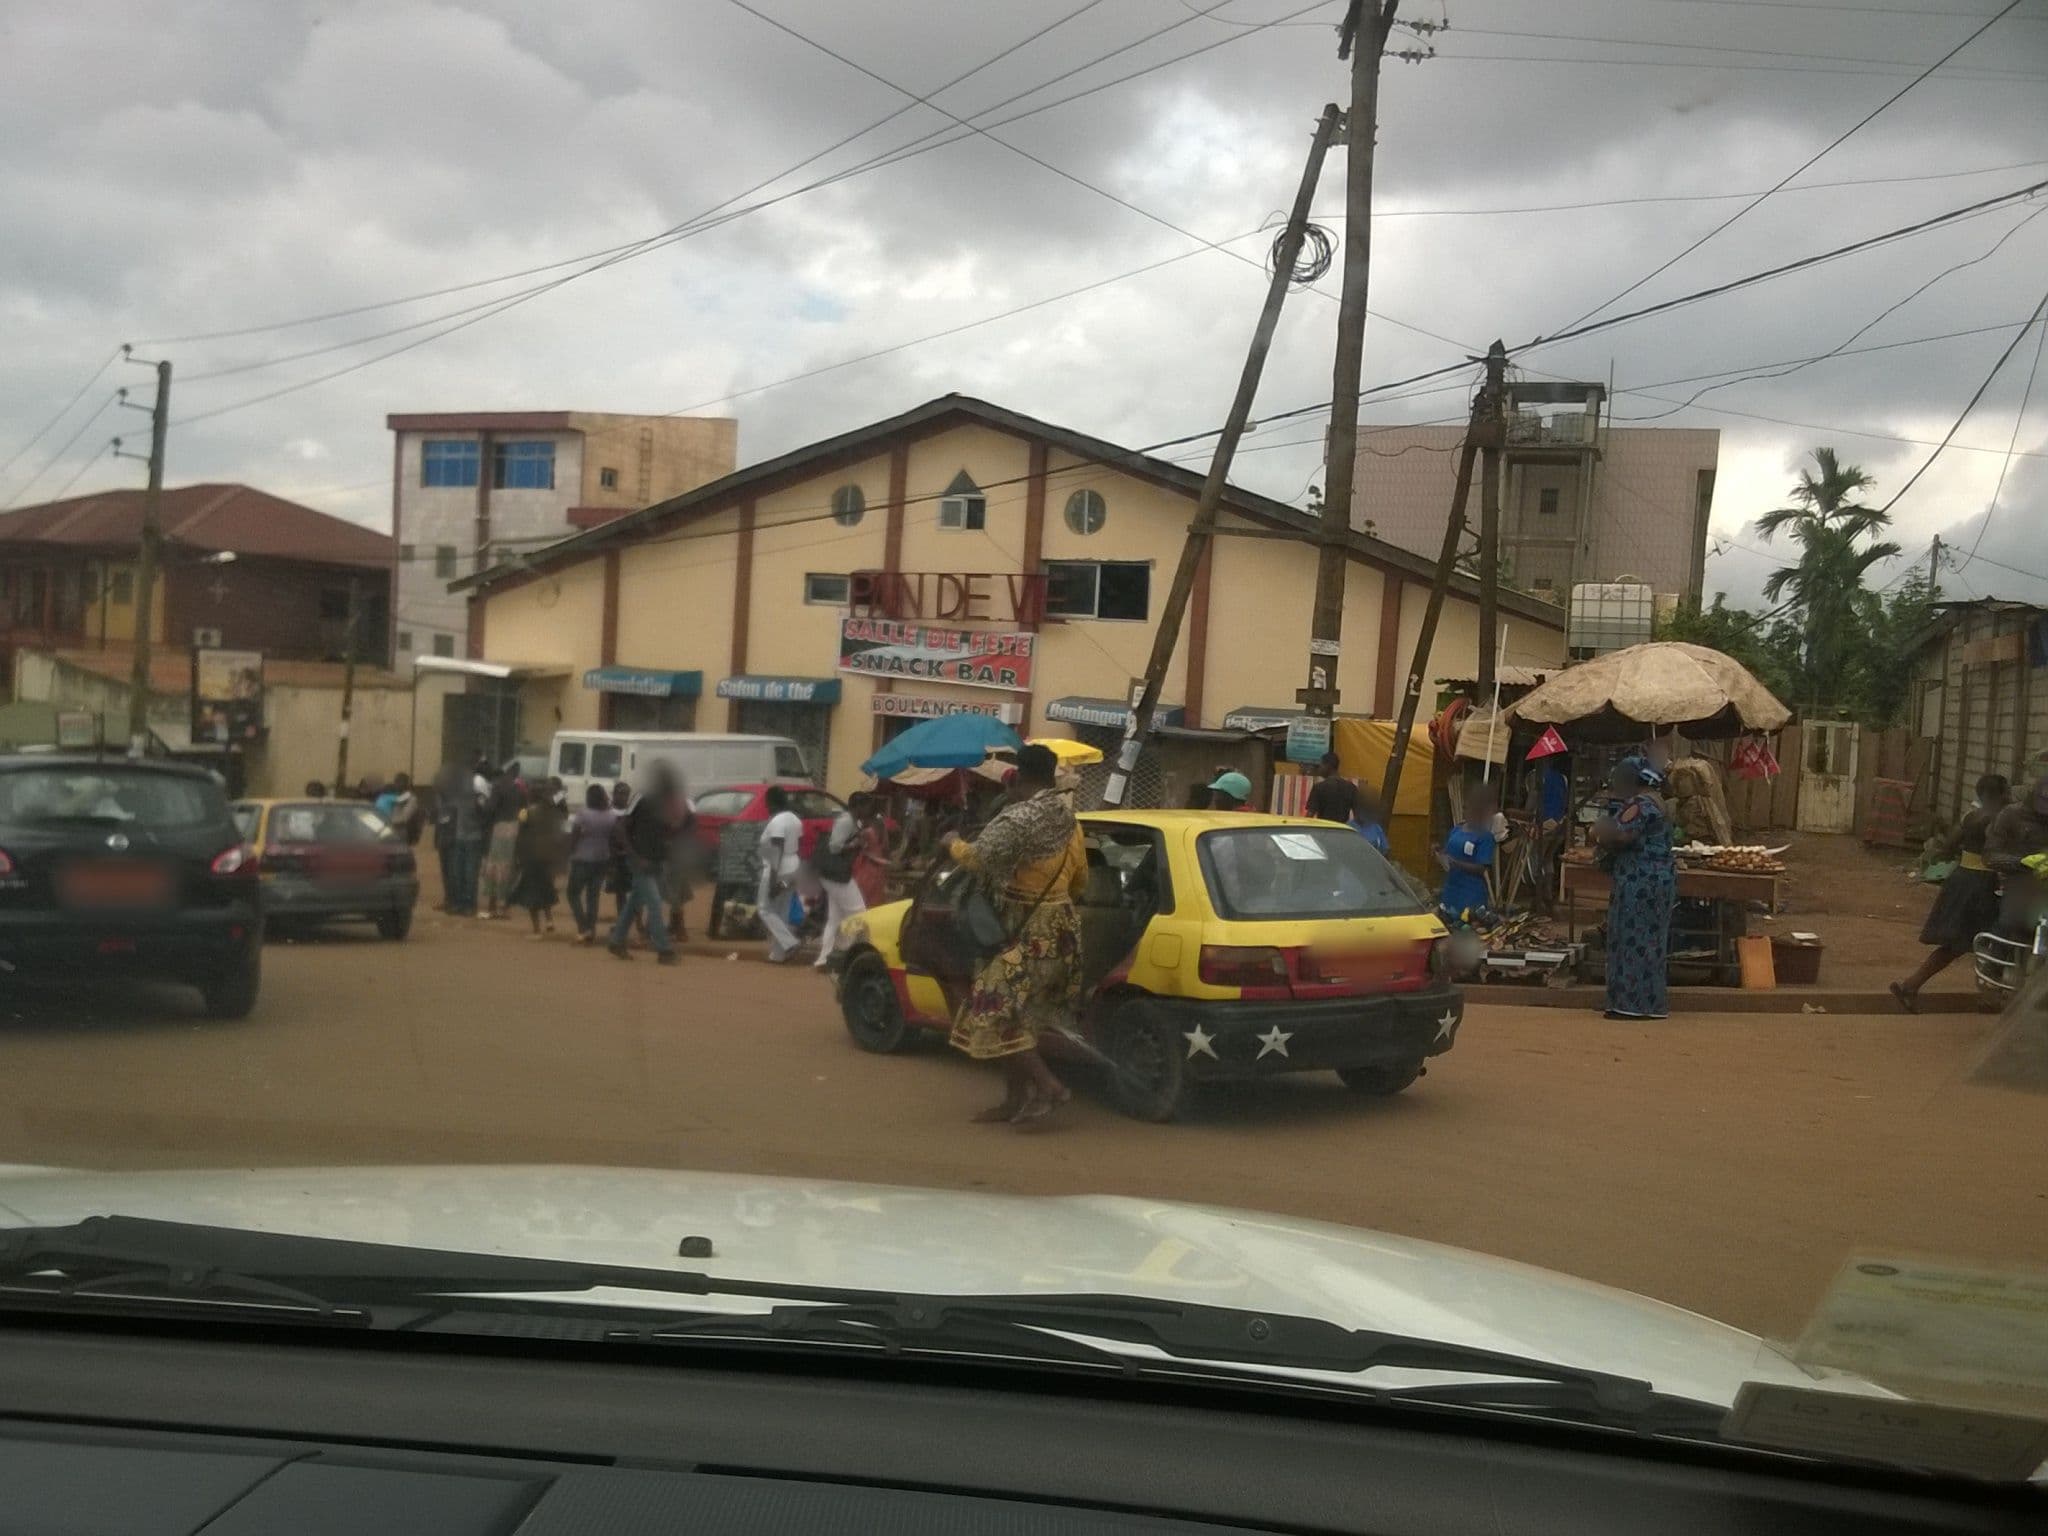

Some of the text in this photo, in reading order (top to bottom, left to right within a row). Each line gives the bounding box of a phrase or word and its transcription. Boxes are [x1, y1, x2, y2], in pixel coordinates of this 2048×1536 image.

[845, 618, 1031, 657] SALLE DE FETE
[852, 653, 1017, 686] SNACK BAR
[720, 679, 761, 698] Salon
[765, 681, 784, 699] de
[872, 698, 1001, 717] BOULANGERIE
